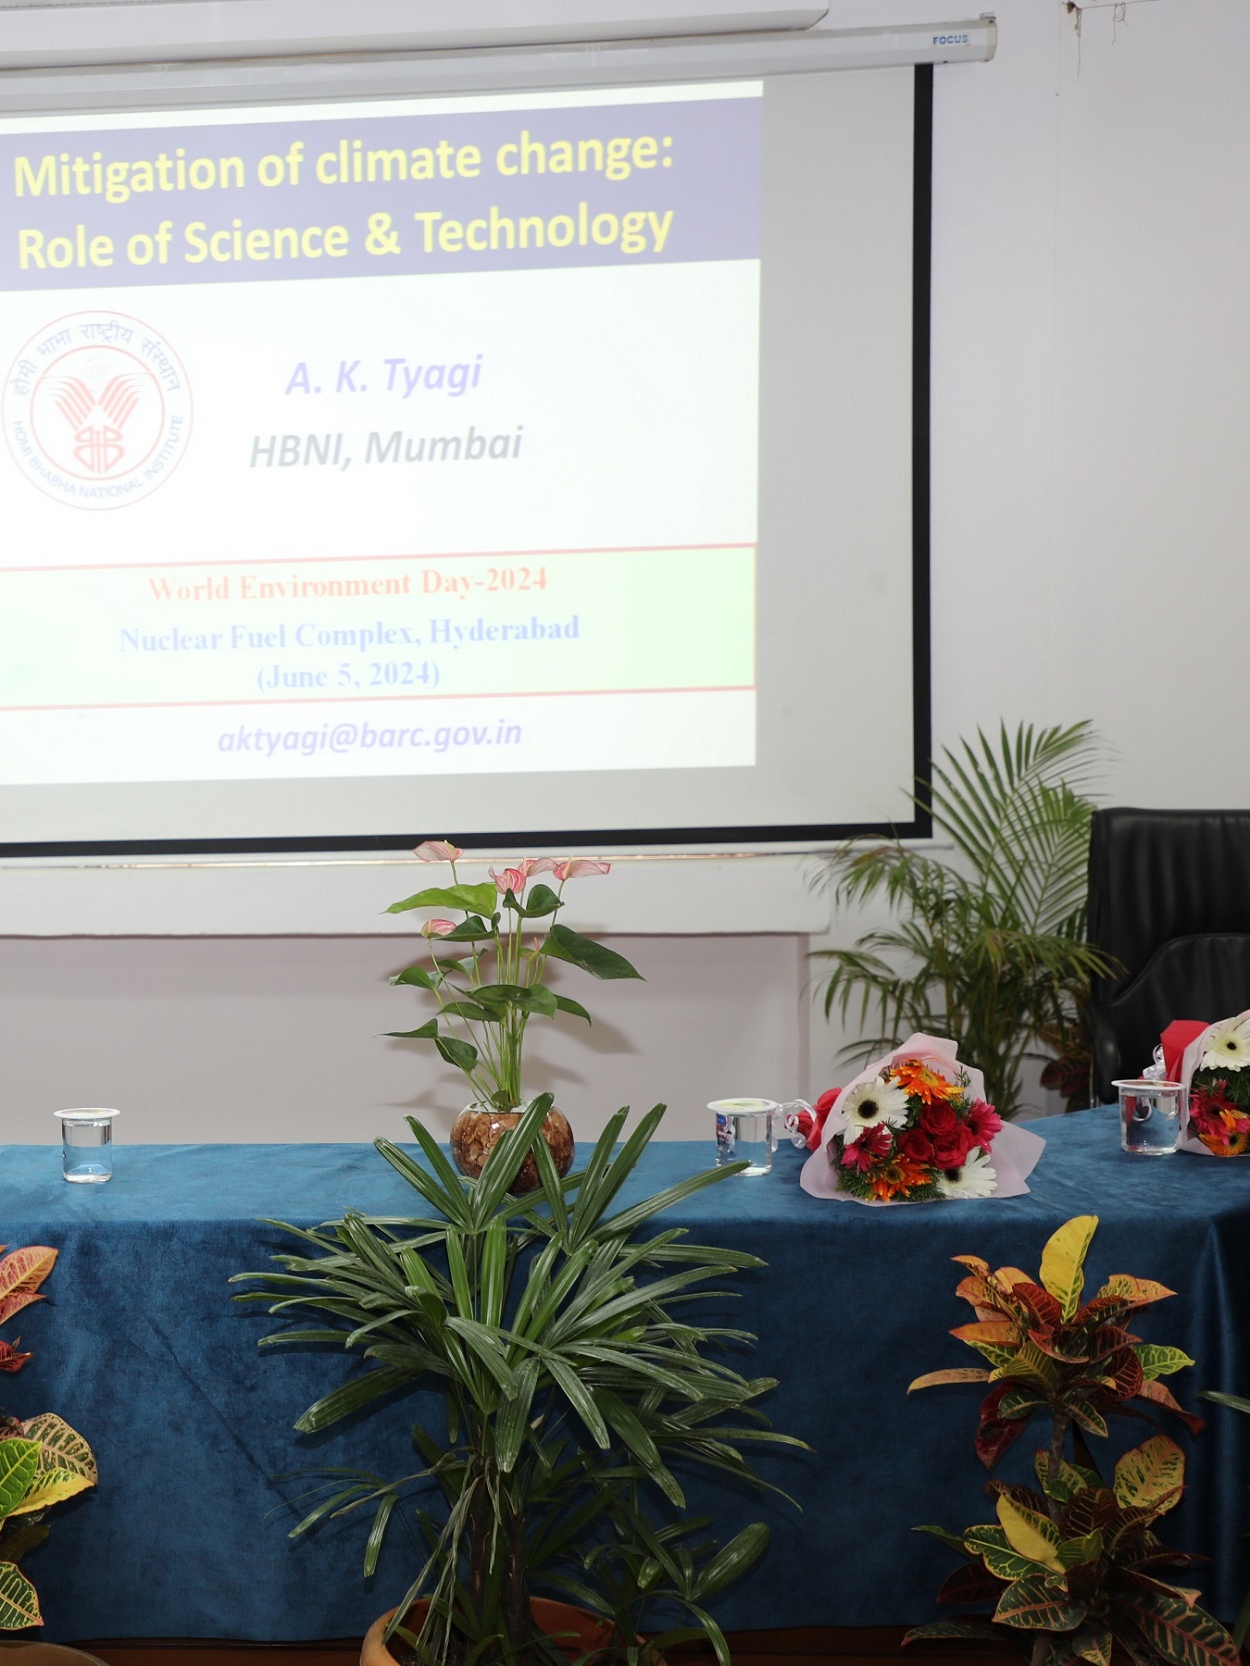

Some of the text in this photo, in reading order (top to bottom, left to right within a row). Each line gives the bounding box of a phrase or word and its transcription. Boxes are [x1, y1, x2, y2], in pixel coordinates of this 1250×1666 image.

[932, 34, 969, 45] FOCUS
[14, 130, 673, 204] Mitigation of climate change:
[18, 201, 674, 269] Role of Science & Technology
[9, 320, 181, 396] होमी भाभा राष्ट्रीय संस्थान
[284, 353, 483, 399] A. K. Tyagi
[13, 415, 183, 499] HOMI BHABHA NATIONAL INSTITUTE
[249, 425, 524, 472] HBNI, Mumbai
[148, 565, 549, 602] World Environment Day-2024
[119, 614, 580, 653] Nuclear Fuel Complex, Hyderabad
[257, 660, 441, 695] (June 5, 2024)
[216, 718, 522, 756] aktyagi@barc.gov.in
